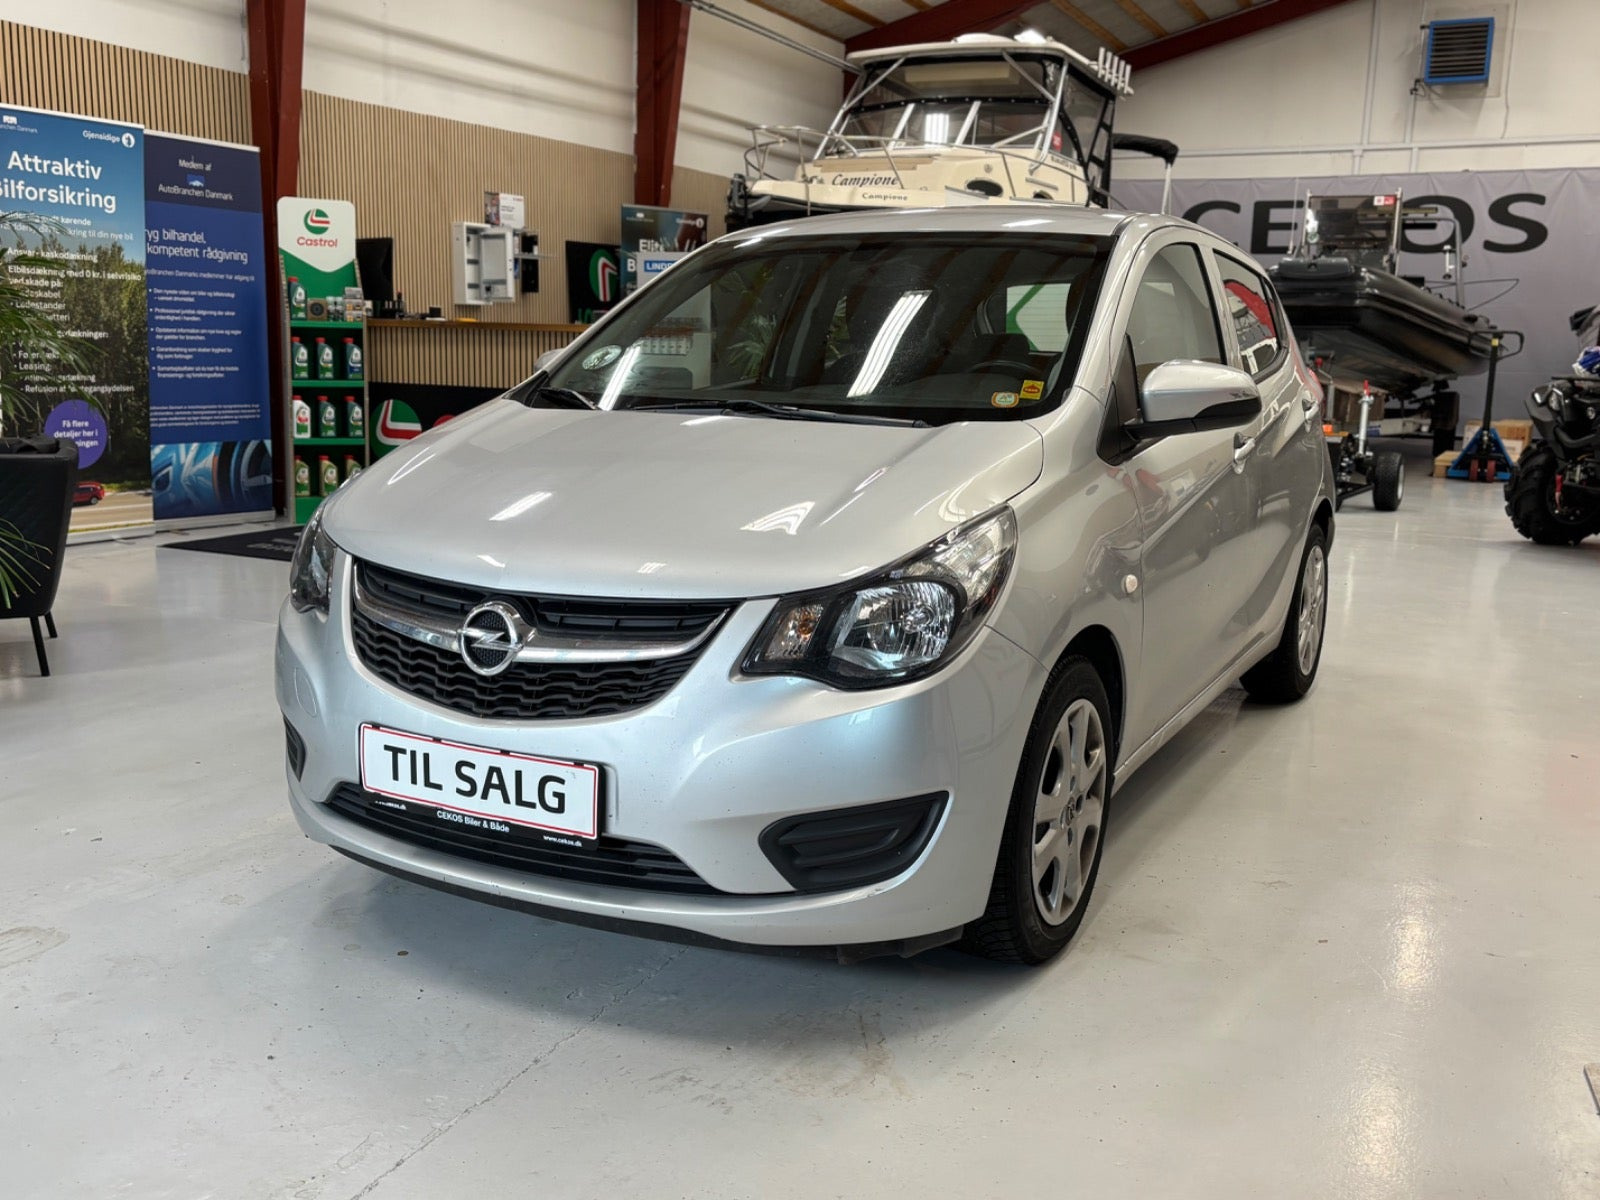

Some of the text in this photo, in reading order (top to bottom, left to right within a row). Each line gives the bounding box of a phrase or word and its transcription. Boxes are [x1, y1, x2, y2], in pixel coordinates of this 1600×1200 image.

[82, 130, 121, 143] Gjensidige
[7, 150, 102, 180] Attraktiv
[178, 158, 204, 170] Medlem
[832, 173, 899, 188] Campione
[158, 184, 233, 200] AutoBranchen Danmark
[862, 192, 908, 201] Campione
[1181, 192, 1549, 255] CEOS
[296, 236, 338, 248] Castrol
[146, 242, 248, 265] kompetent rådgivning
[53, 430, 81, 439] detaljer
[383, 744, 567, 815] TIL SALG
[436, 810, 510, 833] CEKOS Biler & Både
